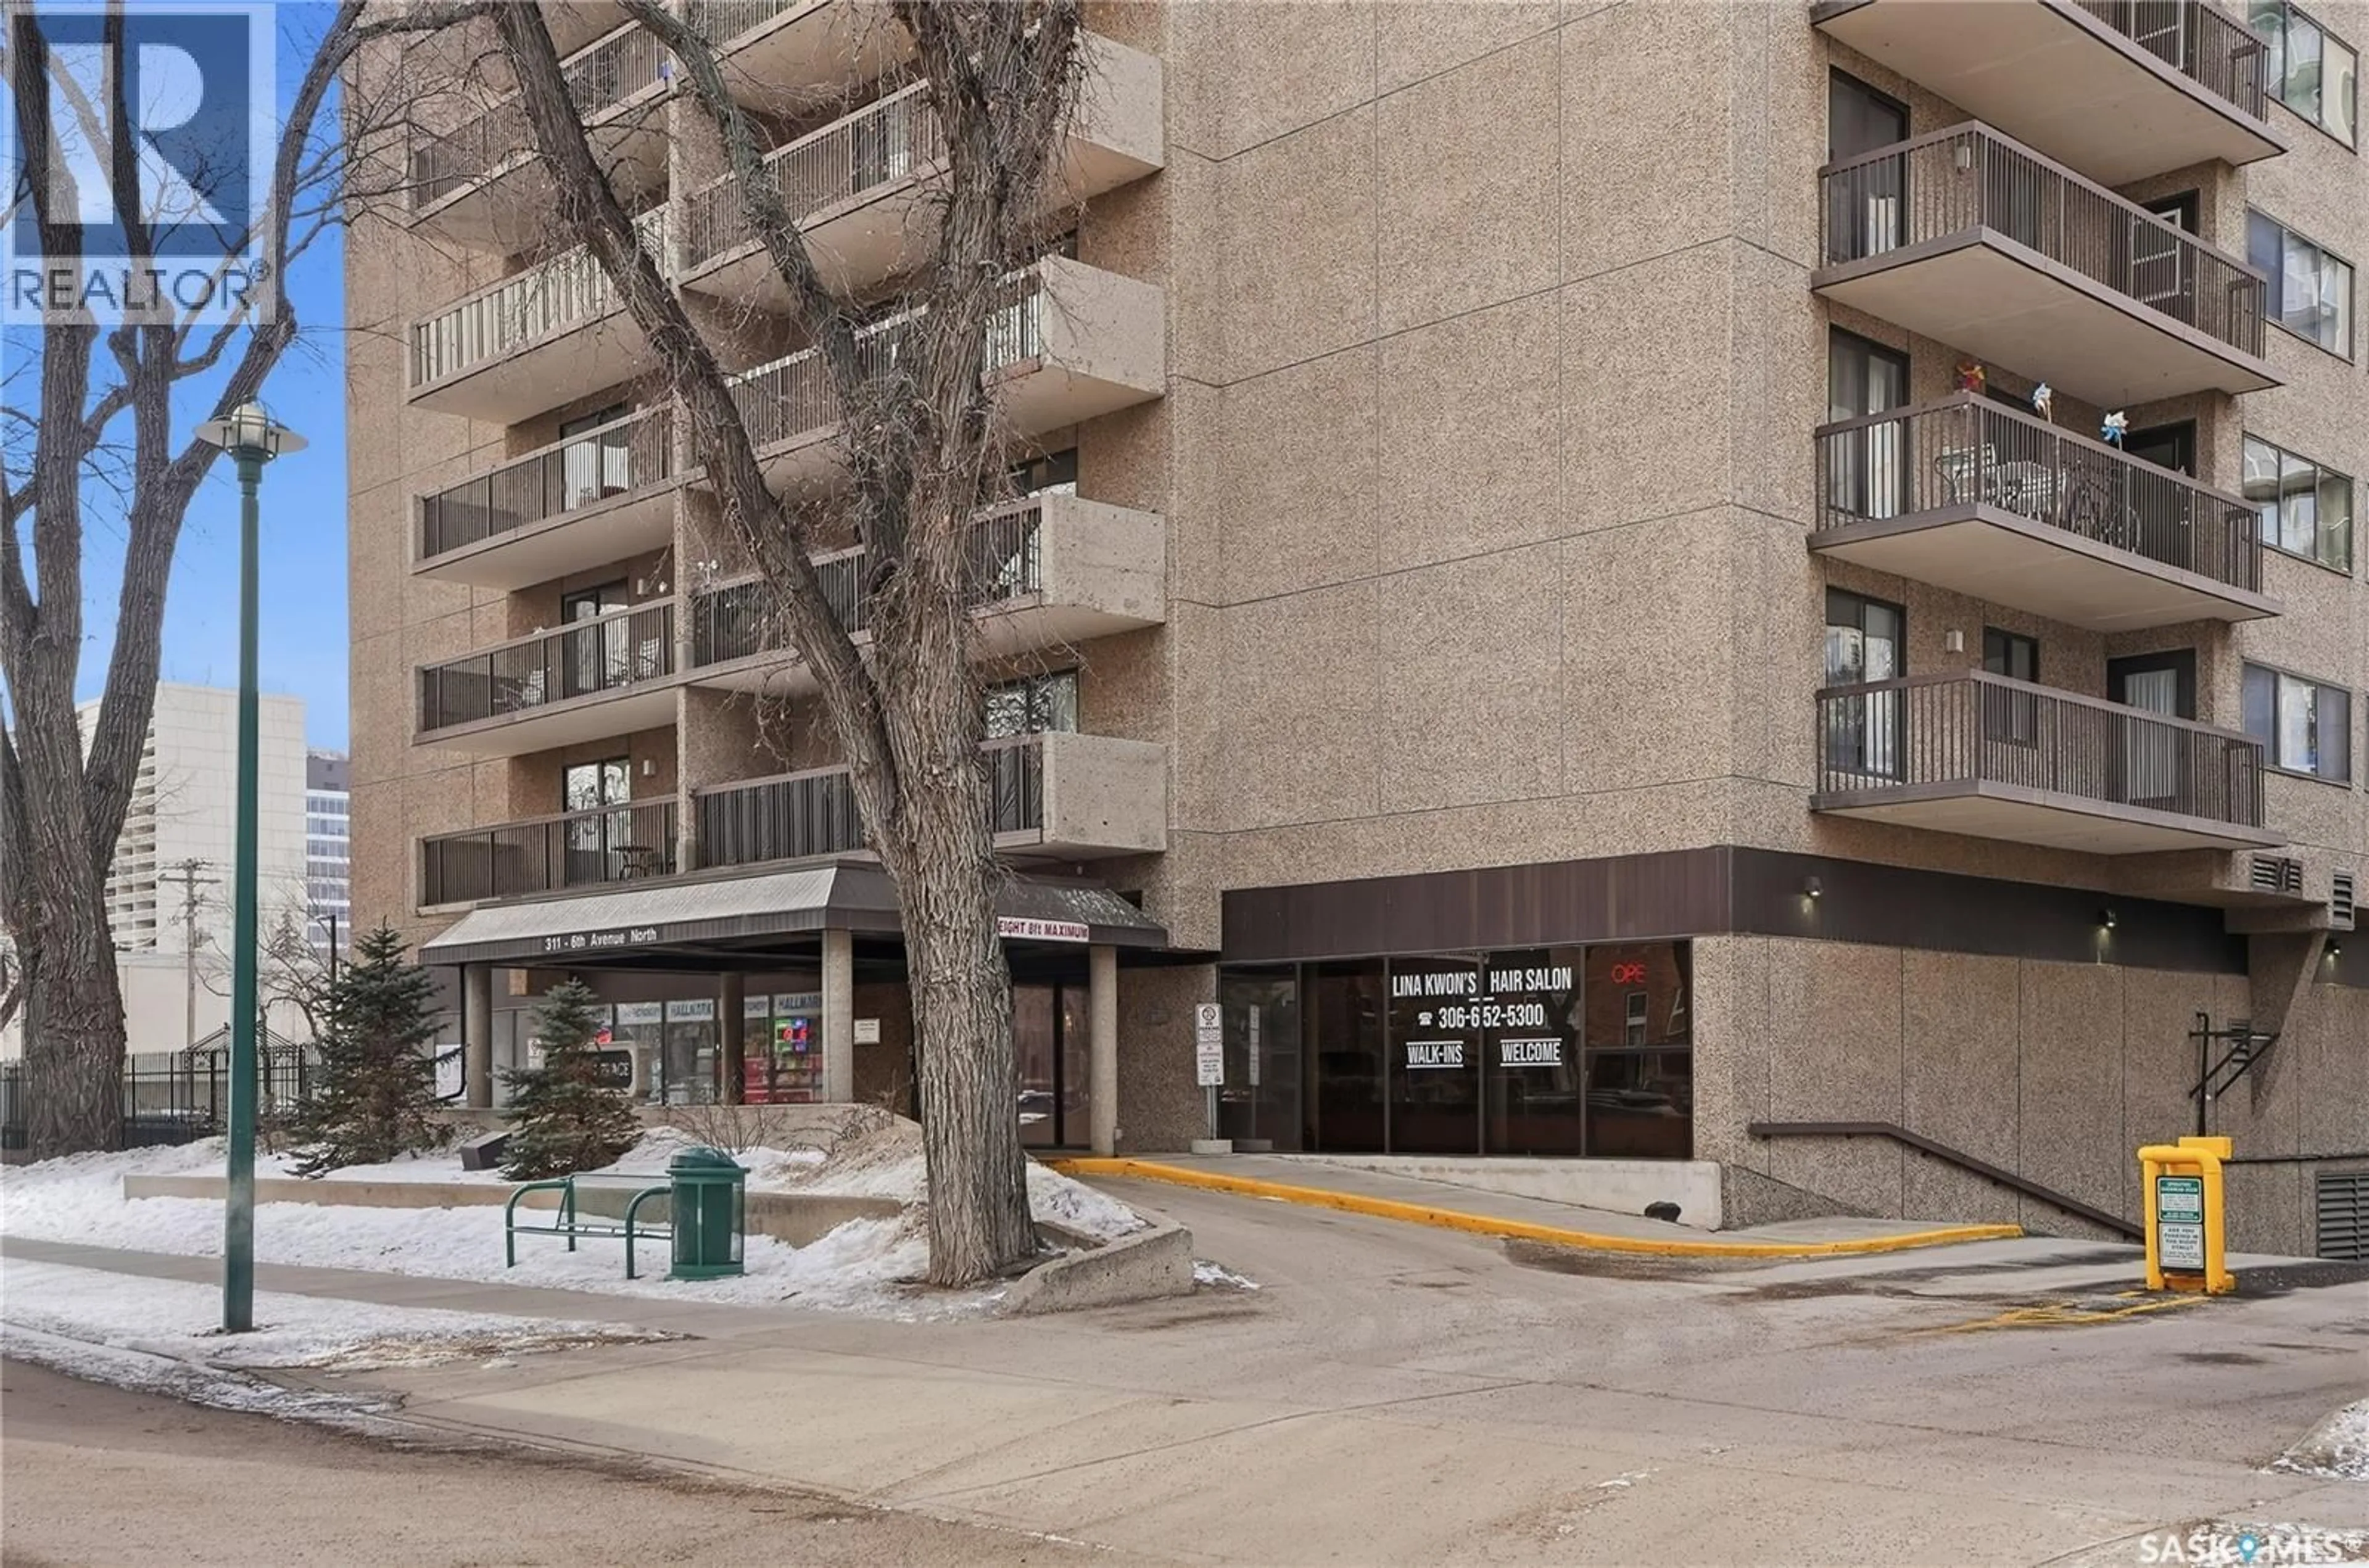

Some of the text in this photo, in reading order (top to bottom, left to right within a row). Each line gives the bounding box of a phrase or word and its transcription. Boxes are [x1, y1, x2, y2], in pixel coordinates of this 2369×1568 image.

[545, 936, 561, 951] 311
[570, 935, 585, 949] 6th
[590, 932, 626, 947] Avenue
[630, 927, 657, 943] North
[997, 920, 1025, 933] EIGHT
[1044, 923, 1088, 938] MAXIMUM
[1392, 967, 1572, 996] LINA KWON'S HAIR SALON
[1439, 1003, 1544, 1029] 306-652-5300
[1407, 1041, 1561, 1063] WALK-INS WELCOME
